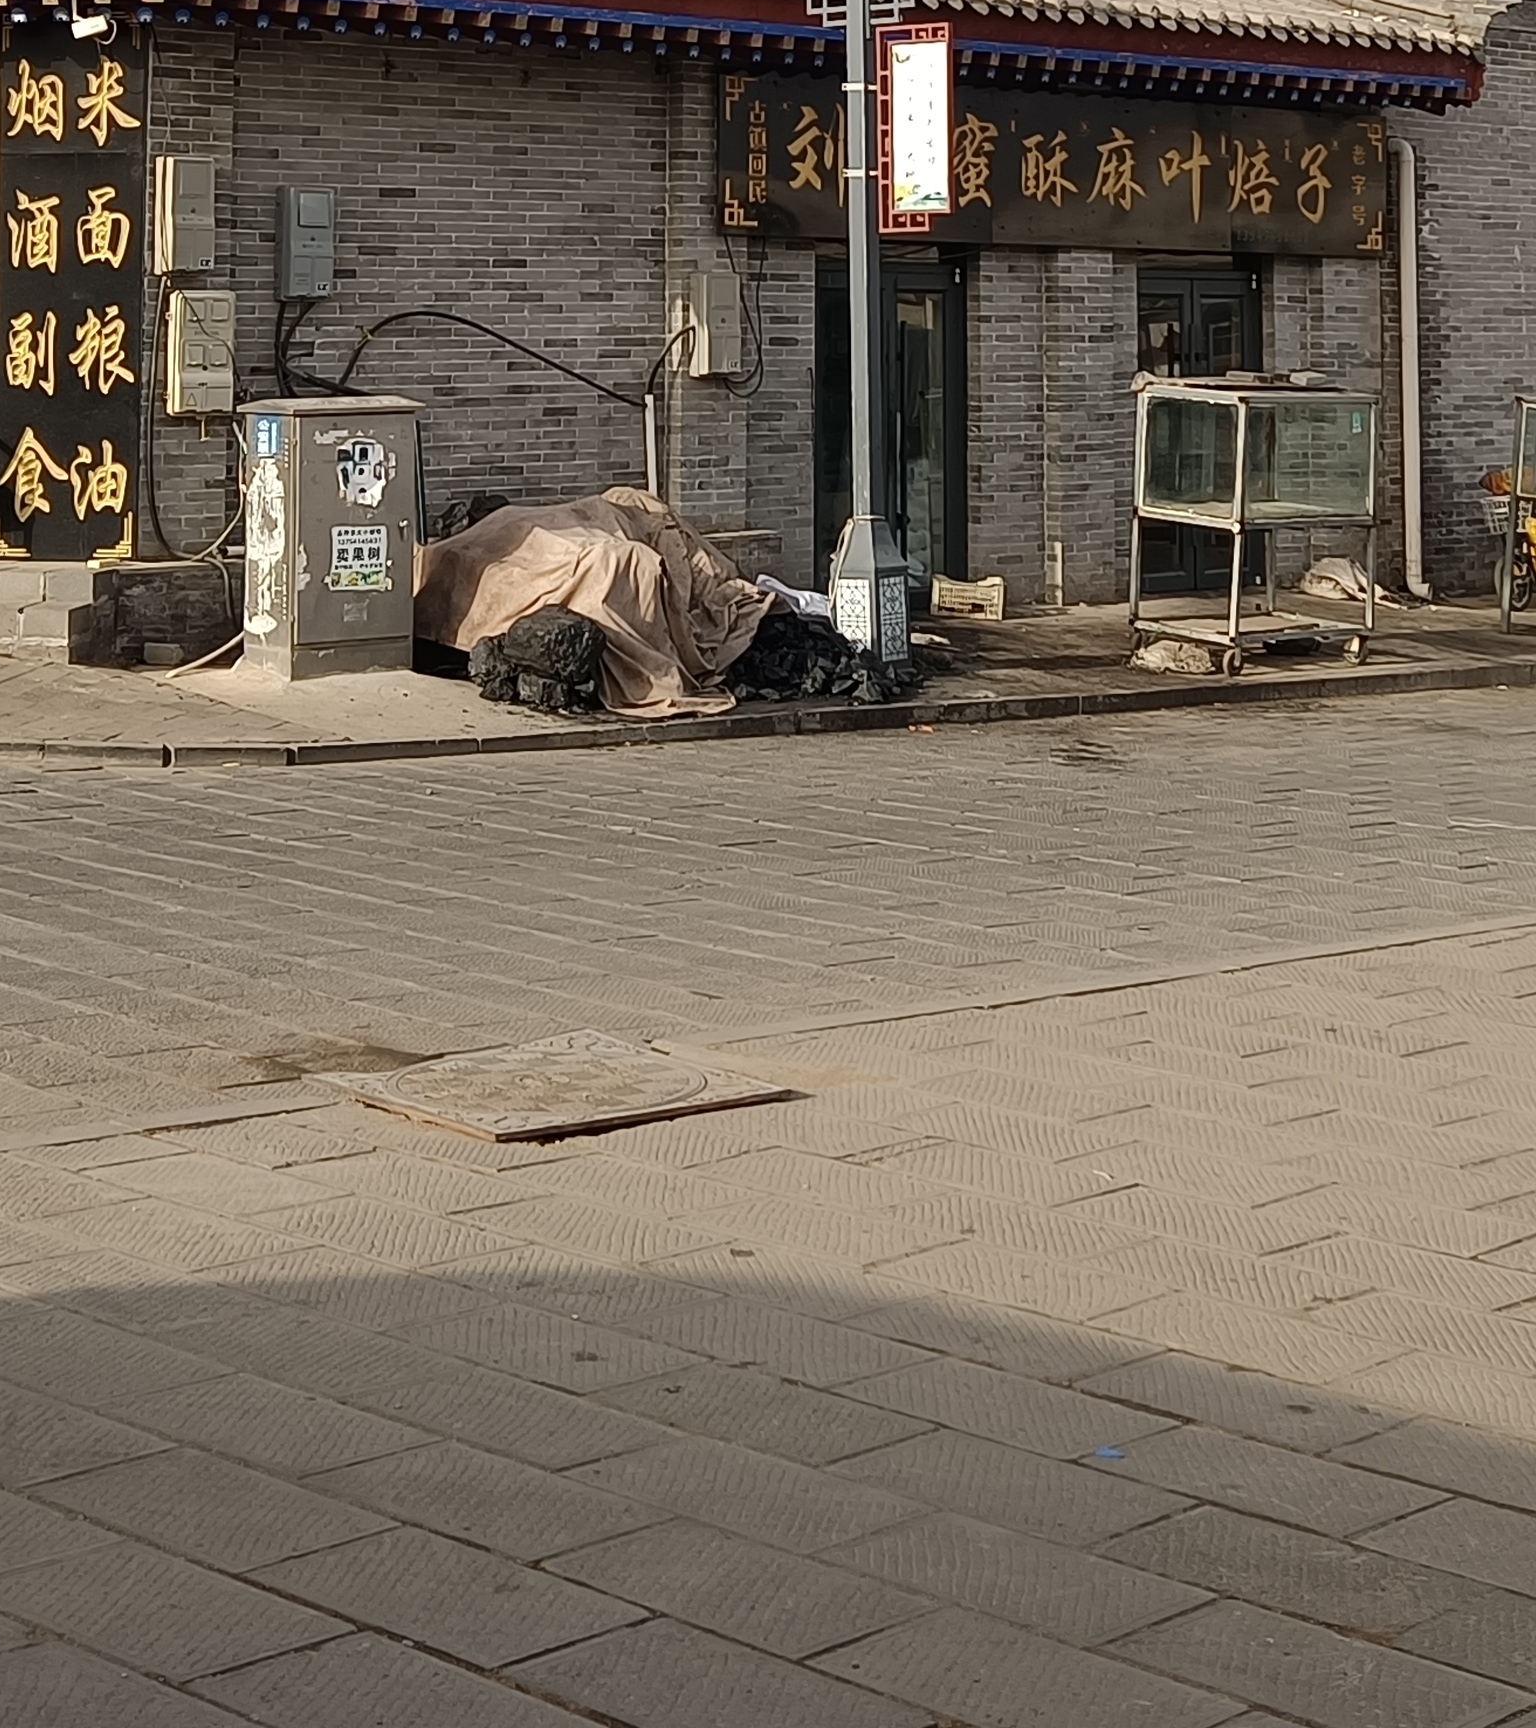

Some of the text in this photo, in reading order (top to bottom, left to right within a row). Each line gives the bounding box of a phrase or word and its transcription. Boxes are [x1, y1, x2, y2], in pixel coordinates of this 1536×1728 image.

[786, 102, 1333, 224] 刘蜜酥麻叶焙子
[1351, 144, 1367, 226] 老字号
[68, 55, 142, 521] 米面粮油
